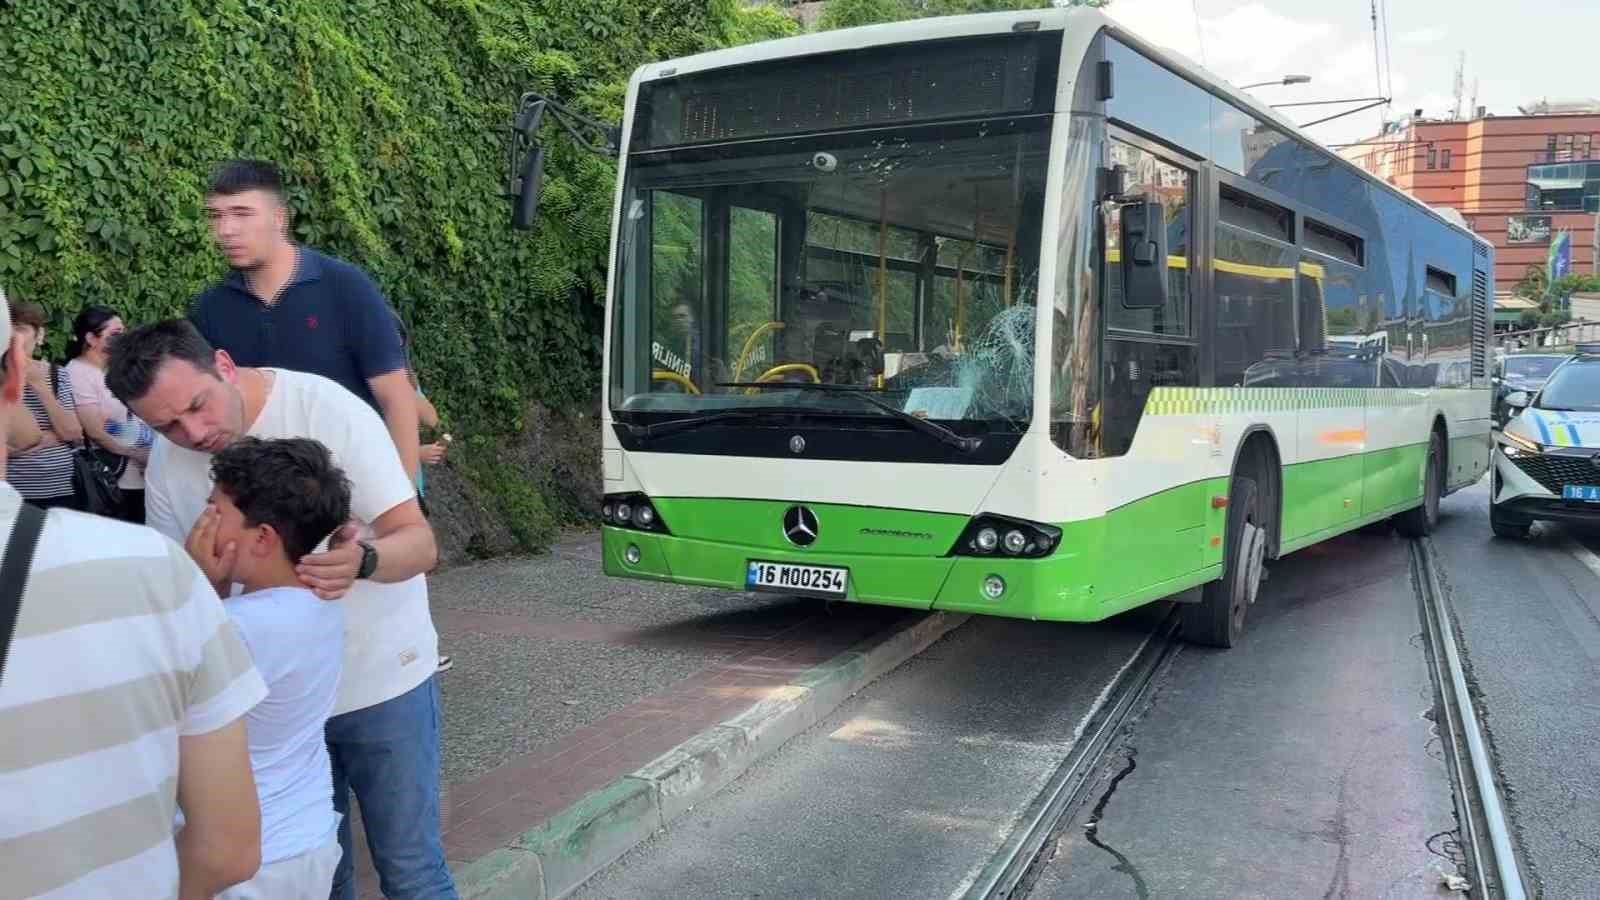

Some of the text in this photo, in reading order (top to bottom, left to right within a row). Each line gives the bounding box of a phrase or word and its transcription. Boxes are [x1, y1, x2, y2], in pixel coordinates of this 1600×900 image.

[1572, 487, 1583, 499] 16
[758, 565, 842, 590] 16 M00254
